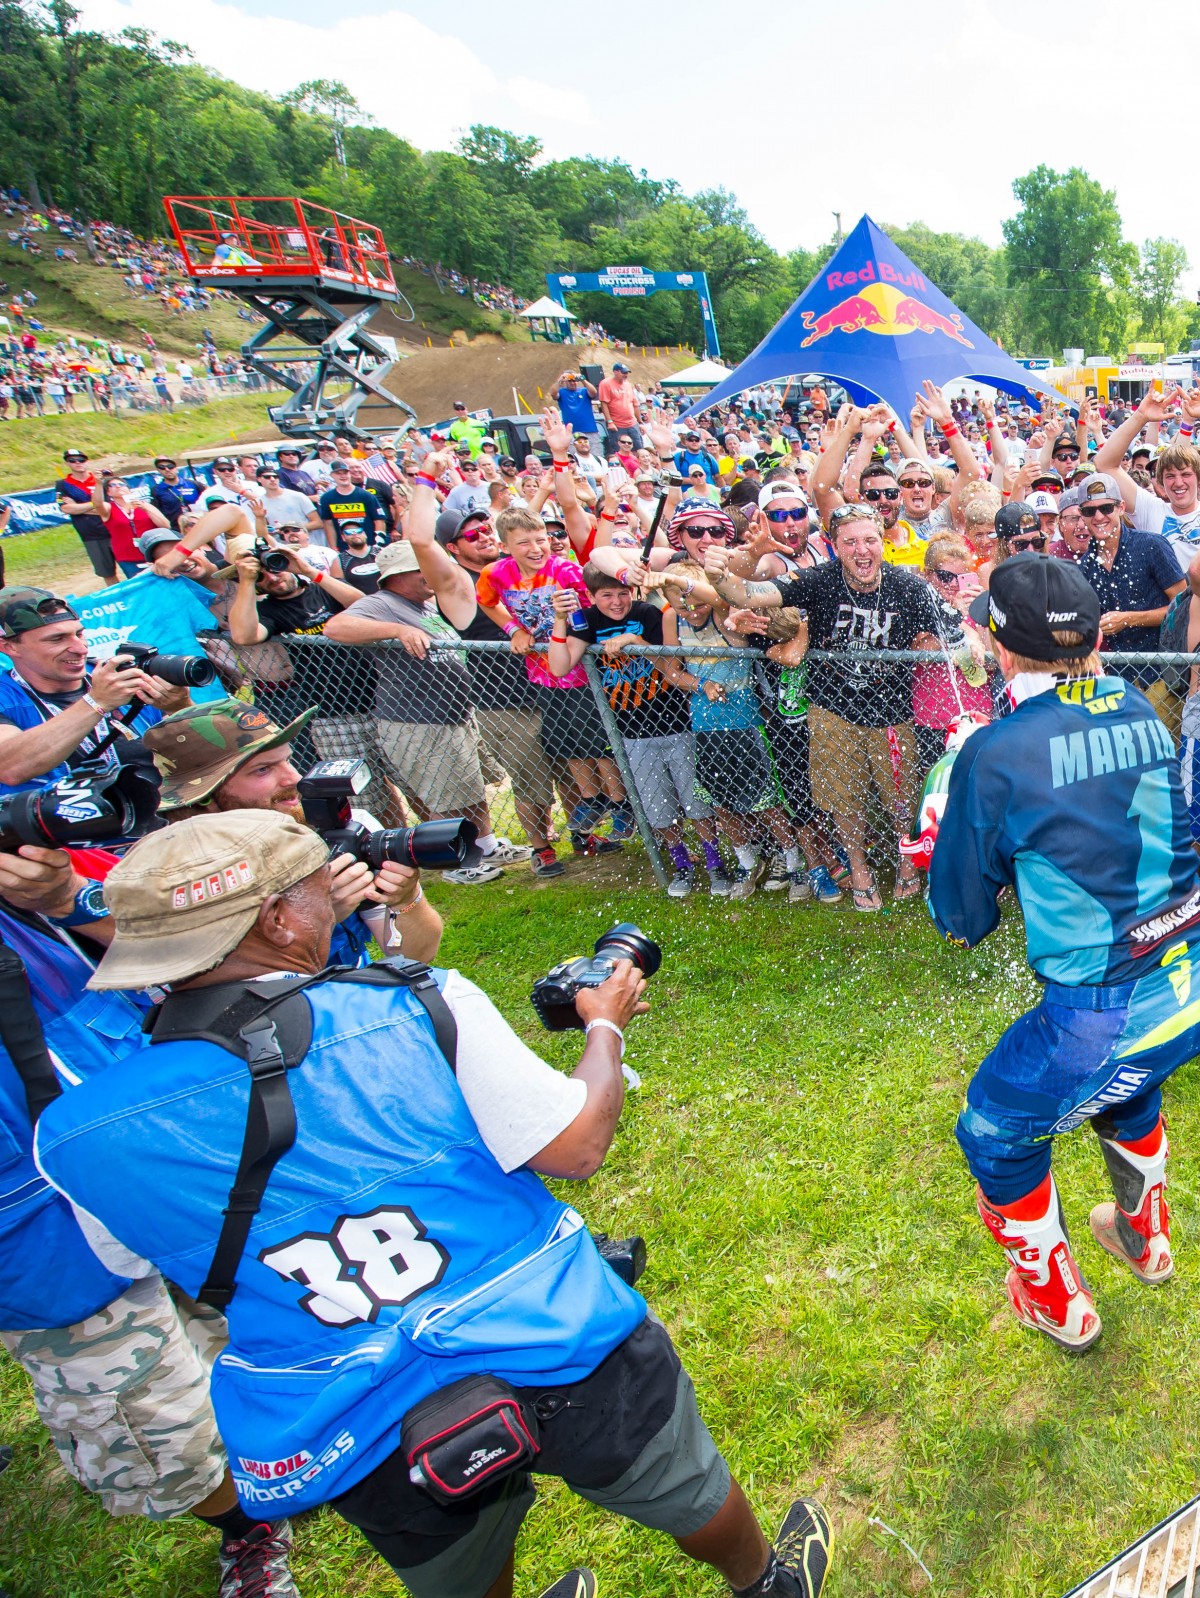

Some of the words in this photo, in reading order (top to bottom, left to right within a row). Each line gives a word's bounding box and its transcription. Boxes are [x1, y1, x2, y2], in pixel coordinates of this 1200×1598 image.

[599, 276, 656, 286] MOTOCROSS
[609, 267, 630, 275] LUCAS
[826, 260, 876, 291] Red
[878, 261, 928, 293] Bull
[613, 287, 646, 295] FINISH
[1120, 365, 1162, 376] Bubba's
[334, 503, 361, 511] FXR
[1049, 719, 1176, 789] MARTIN
[1127, 766, 1175, 916] 1
[1072, 1066, 1149, 1122] YAMAHA
[259, 1205, 451, 1328] 38
[241, 1458, 271, 1480] LUCAS
[274, 1453, 308, 1477] OIL
[463, 1446, 503, 1477] HUSKY
